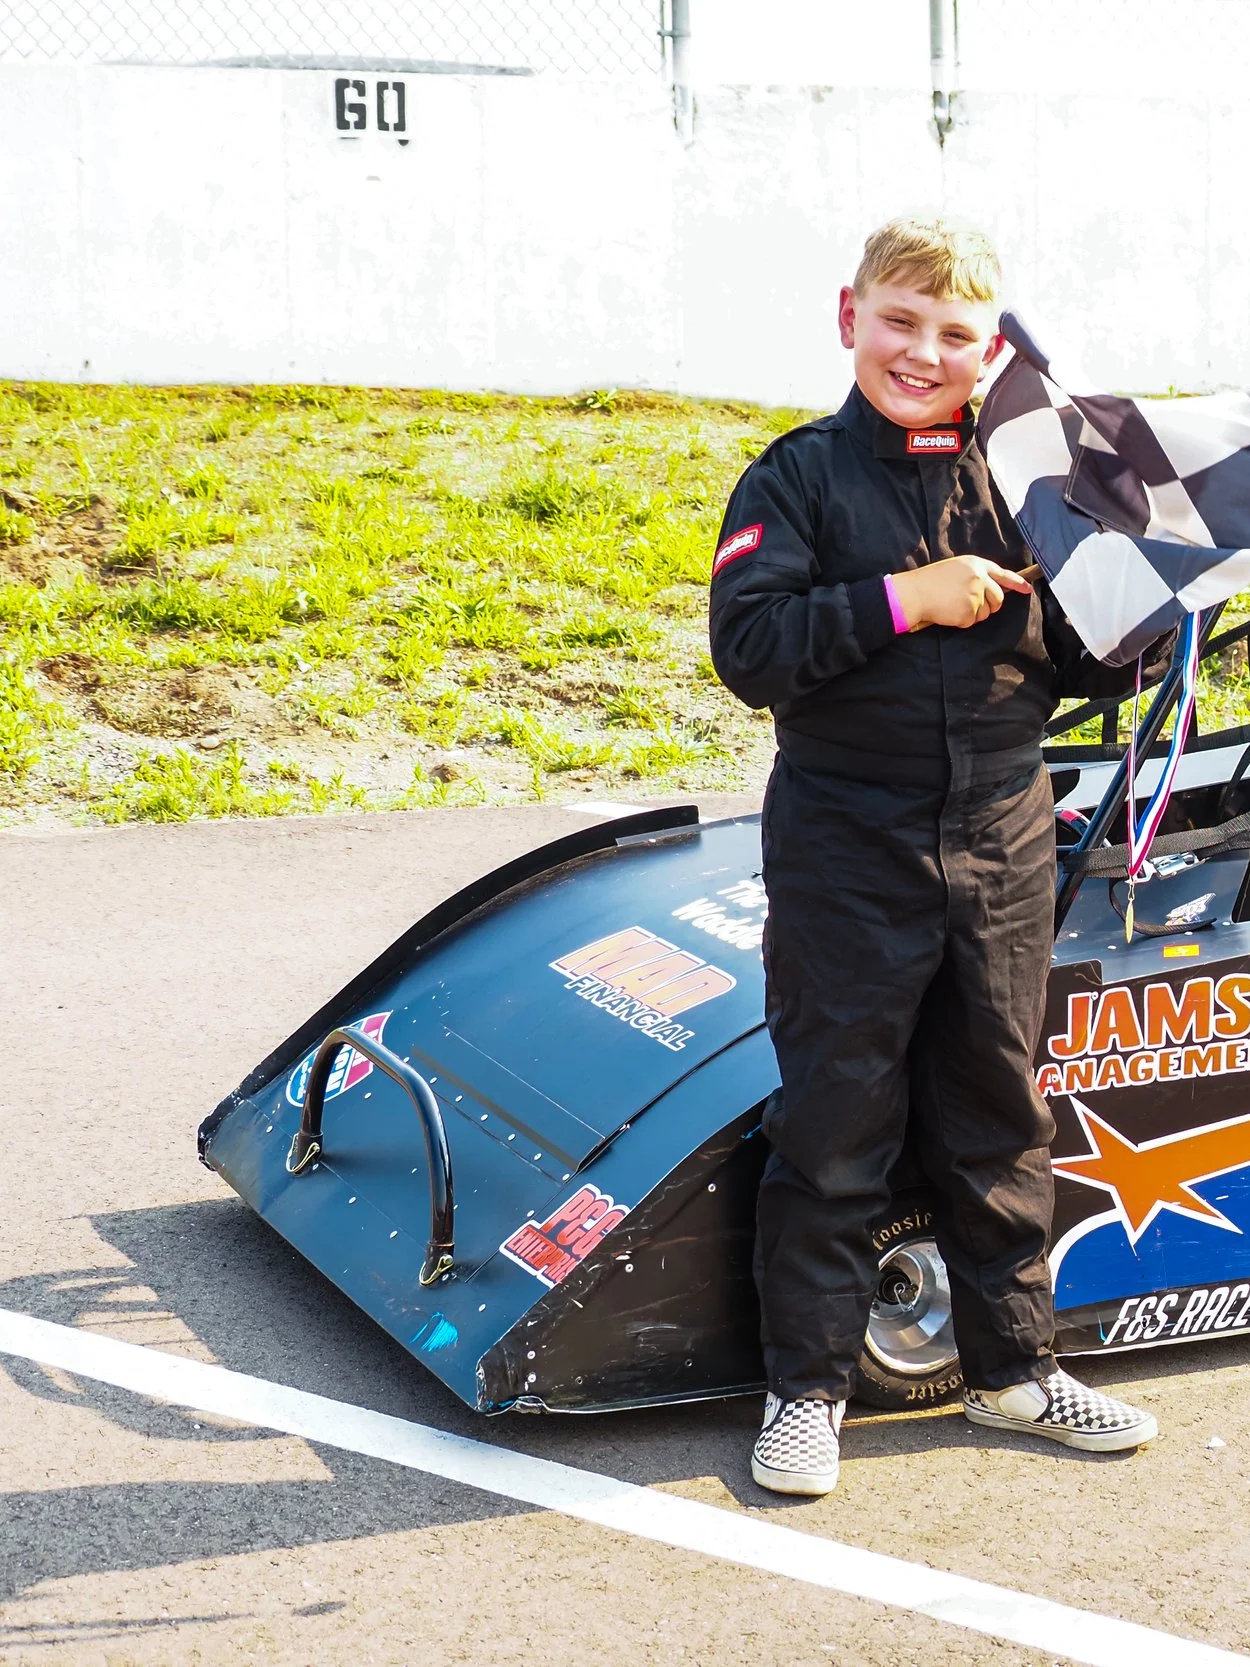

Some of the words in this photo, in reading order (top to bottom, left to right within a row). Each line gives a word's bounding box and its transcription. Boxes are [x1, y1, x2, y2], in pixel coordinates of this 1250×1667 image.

[335, 78, 406, 132] 60
[912, 435, 957, 448] RaceQuip
[563, 973, 696, 1052] FINANCIAL
[872, 1209, 933, 1251] oosie
